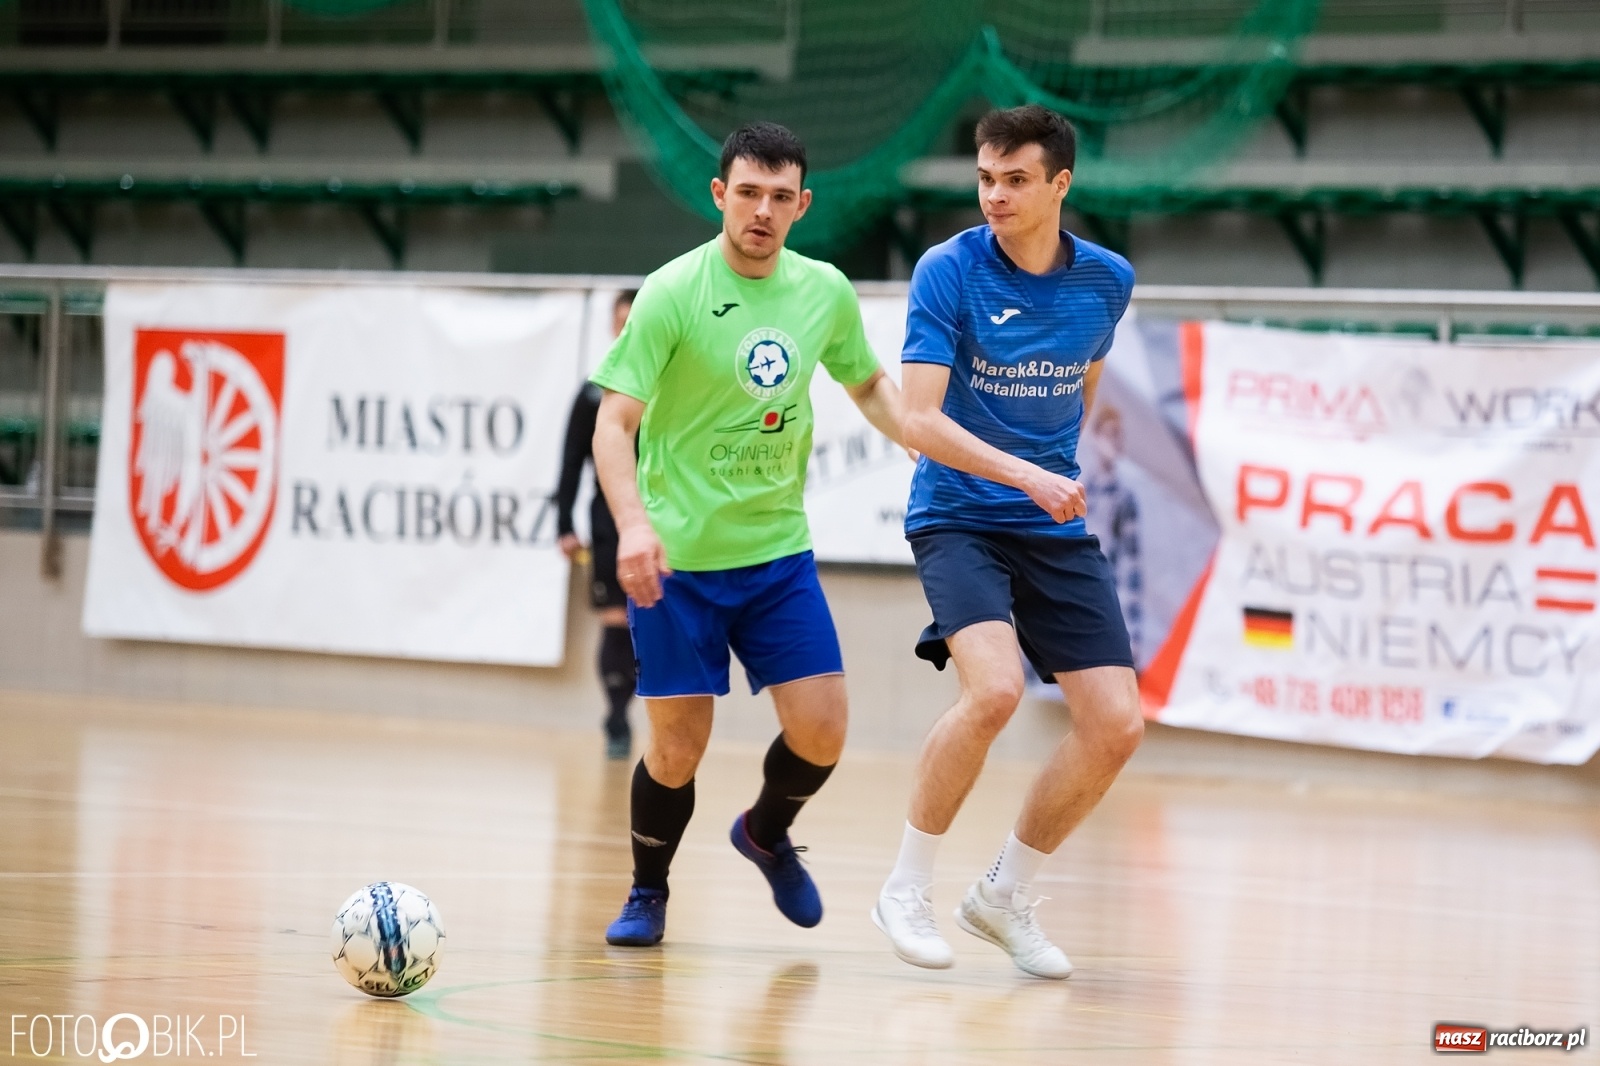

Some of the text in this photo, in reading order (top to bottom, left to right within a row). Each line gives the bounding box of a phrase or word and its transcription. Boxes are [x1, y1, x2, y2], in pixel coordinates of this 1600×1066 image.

[972, 356, 1091, 378] Marek&Darius
[745, 380, 790, 397] MANIAC
[970, 374, 1048, 397] Metallbau
[326, 392, 526, 457] MIASTO
[710, 441, 793, 462] OKINAWA
[710, 465, 749, 477] sushi
[754, 465, 762, 475] &
[290, 469, 557, 549] RACIBÓRZ
[1235, 463, 1598, 548] PRACA
[1242, 542, 1523, 610] AUSTRIA
[1306, 609, 1588, 678] NIEMCY
[364, 967, 430, 992] SELECT
